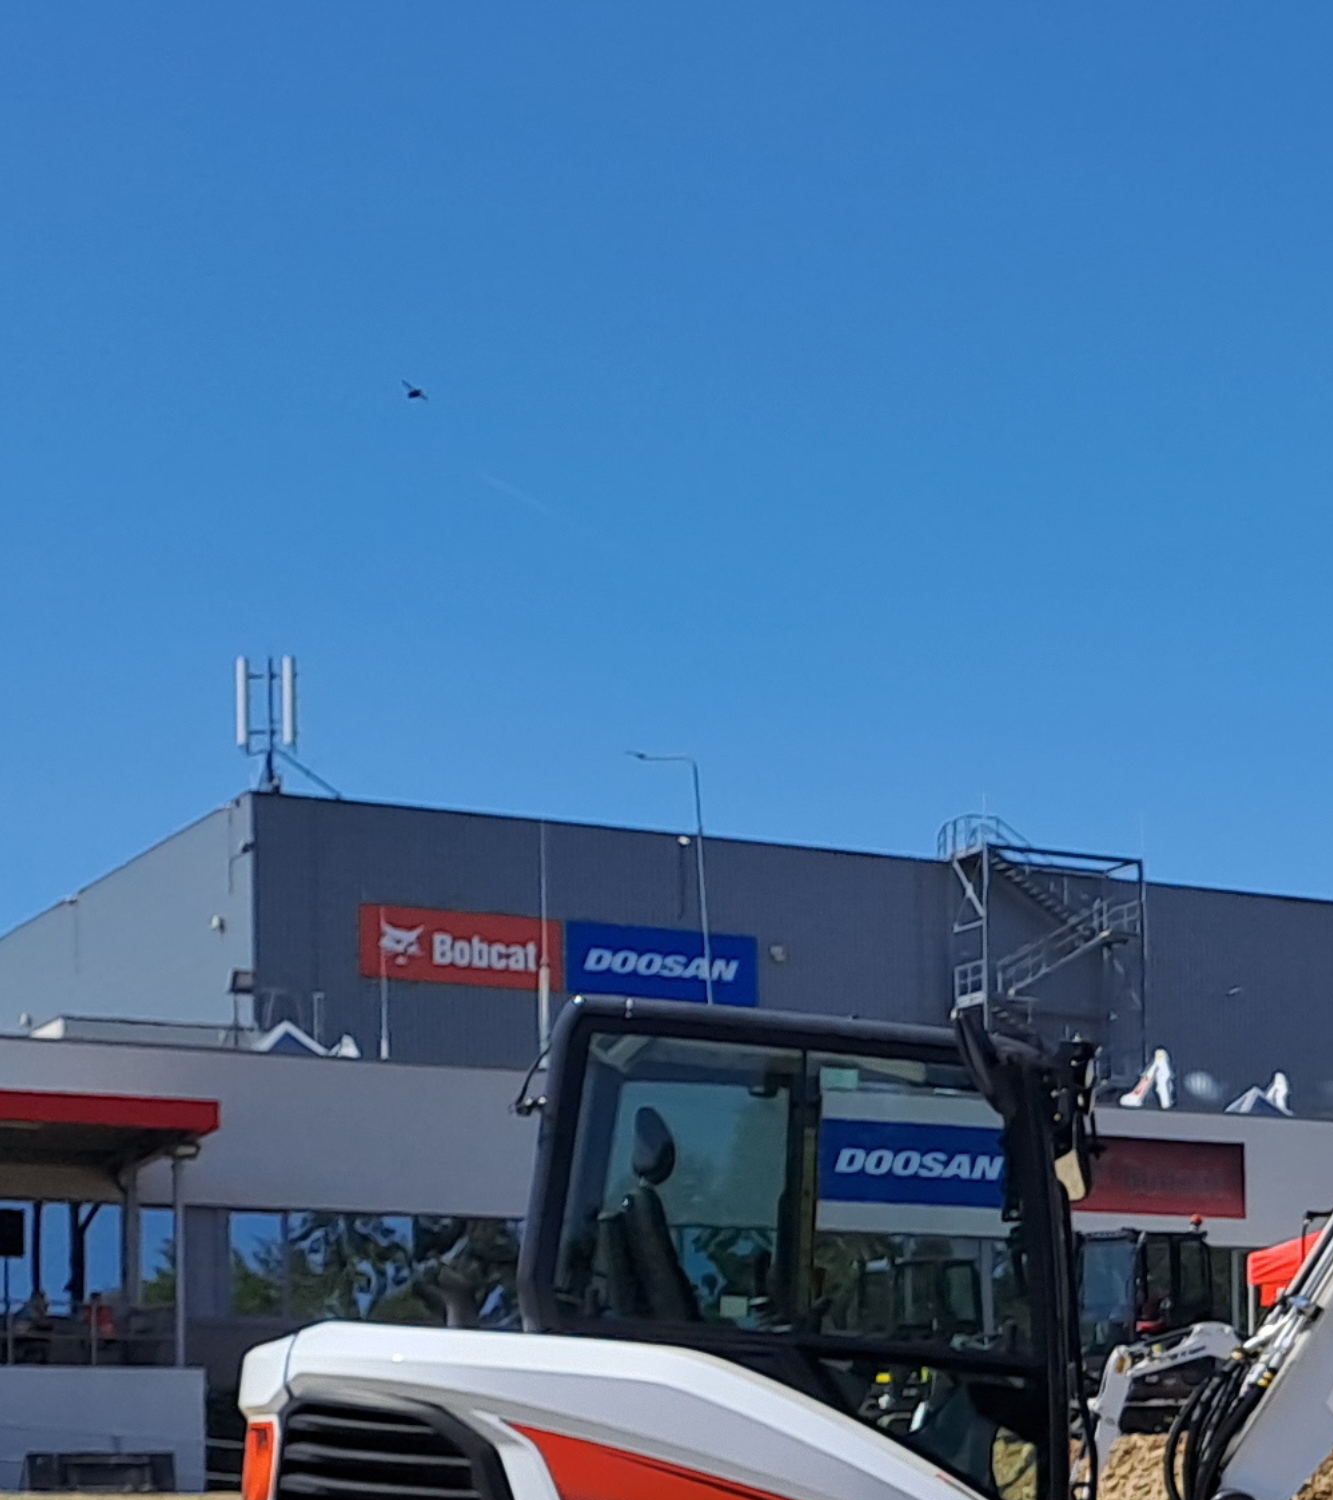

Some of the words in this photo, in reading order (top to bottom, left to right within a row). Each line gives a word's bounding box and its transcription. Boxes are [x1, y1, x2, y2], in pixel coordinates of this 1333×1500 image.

[432, 931, 539, 973] Bobcat
[582, 946, 740, 983] DOOSAN
[833, 1146, 1004, 1182] DOOSAN
